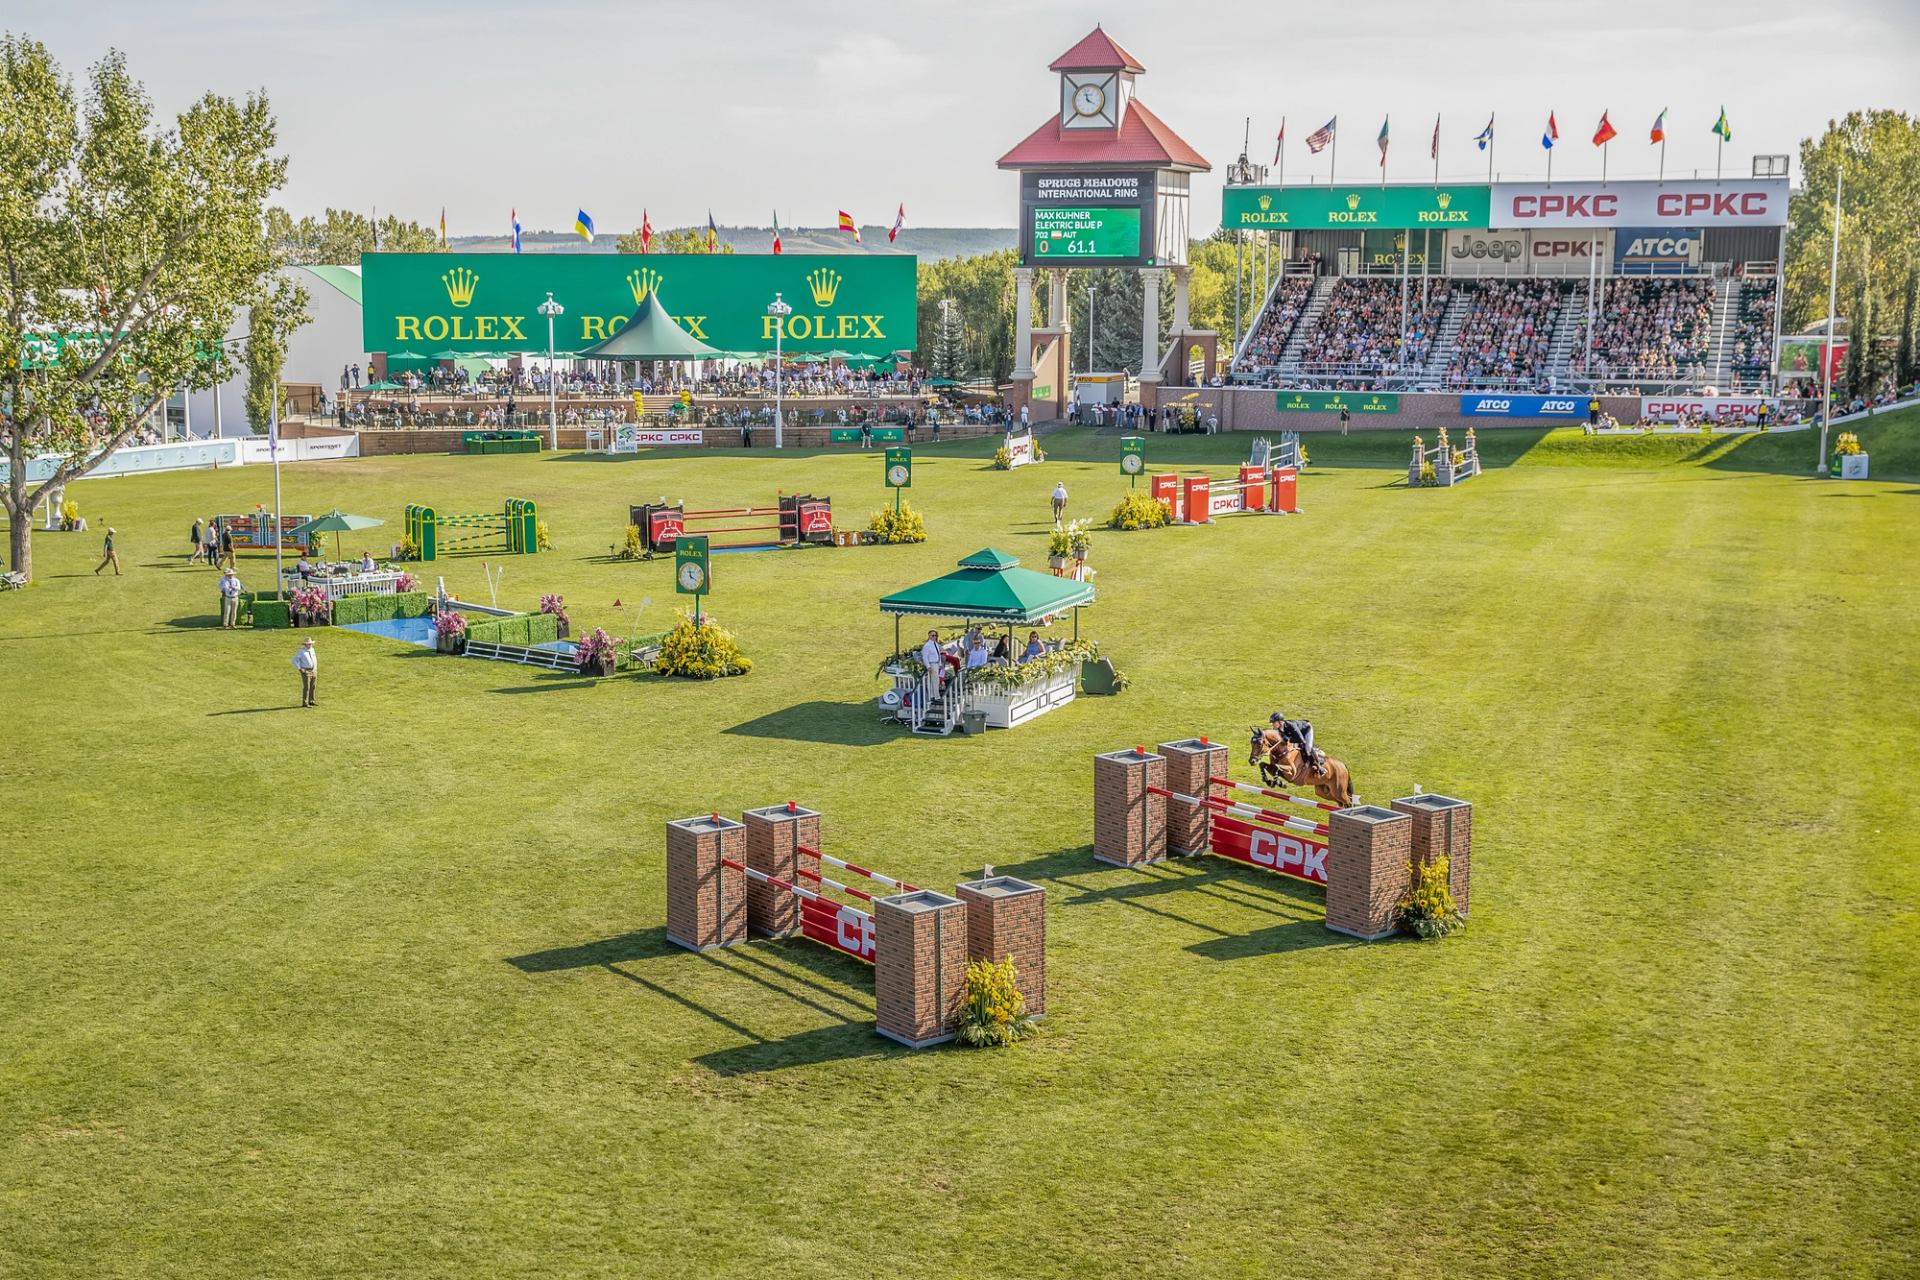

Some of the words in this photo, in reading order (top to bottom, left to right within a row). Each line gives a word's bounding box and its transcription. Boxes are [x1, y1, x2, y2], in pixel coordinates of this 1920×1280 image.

[1038, 178, 1081, 188] SPRUCE
[1083, 178, 1138, 187] MEADOWS
[1038, 189, 1112, 198] INTERNATIONAL
[1114, 188, 1138, 197] RING
[1513, 195, 1617, 217] CPKC
[1657, 193, 1768, 216] CPKC
[1035, 211, 1054, 219] MAX
[1055, 211, 1090, 219] KUHNER
[1241, 212, 1288, 223] ROLEX
[1328, 211, 1377, 222] ROLEX
[1418, 211, 1468, 222] ROLEX
[1035, 221, 1073, 229] ELEKTRIC
[1075, 221, 1096, 229] BLUE
[1096, 221, 1103, 229] P
[1035, 231, 1048, 239] 702
[1067, 240, 1096, 253] 61.1
[1451, 235, 1522, 263] Jeep
[1625, 238, 1691, 256] ATCO
[1374, 254, 1426, 265] ROEX
[395, 315, 528, 340] ROLEX
[580, 315, 709, 340] ROX
[761, 315, 887, 340] ROLEX
[1477, 400, 1510, 409] ATCO
[1541, 401, 1575, 410] ATCO
[1648, 403, 1703, 415] CPKC
[1716, 404, 1758, 416] CPK
[669, 433, 700, 441] CPKC
[1247, 472, 1264, 480] CPKC
[1213, 498, 1240, 510] CPKC
[1250, 829, 1328, 881] CPK
